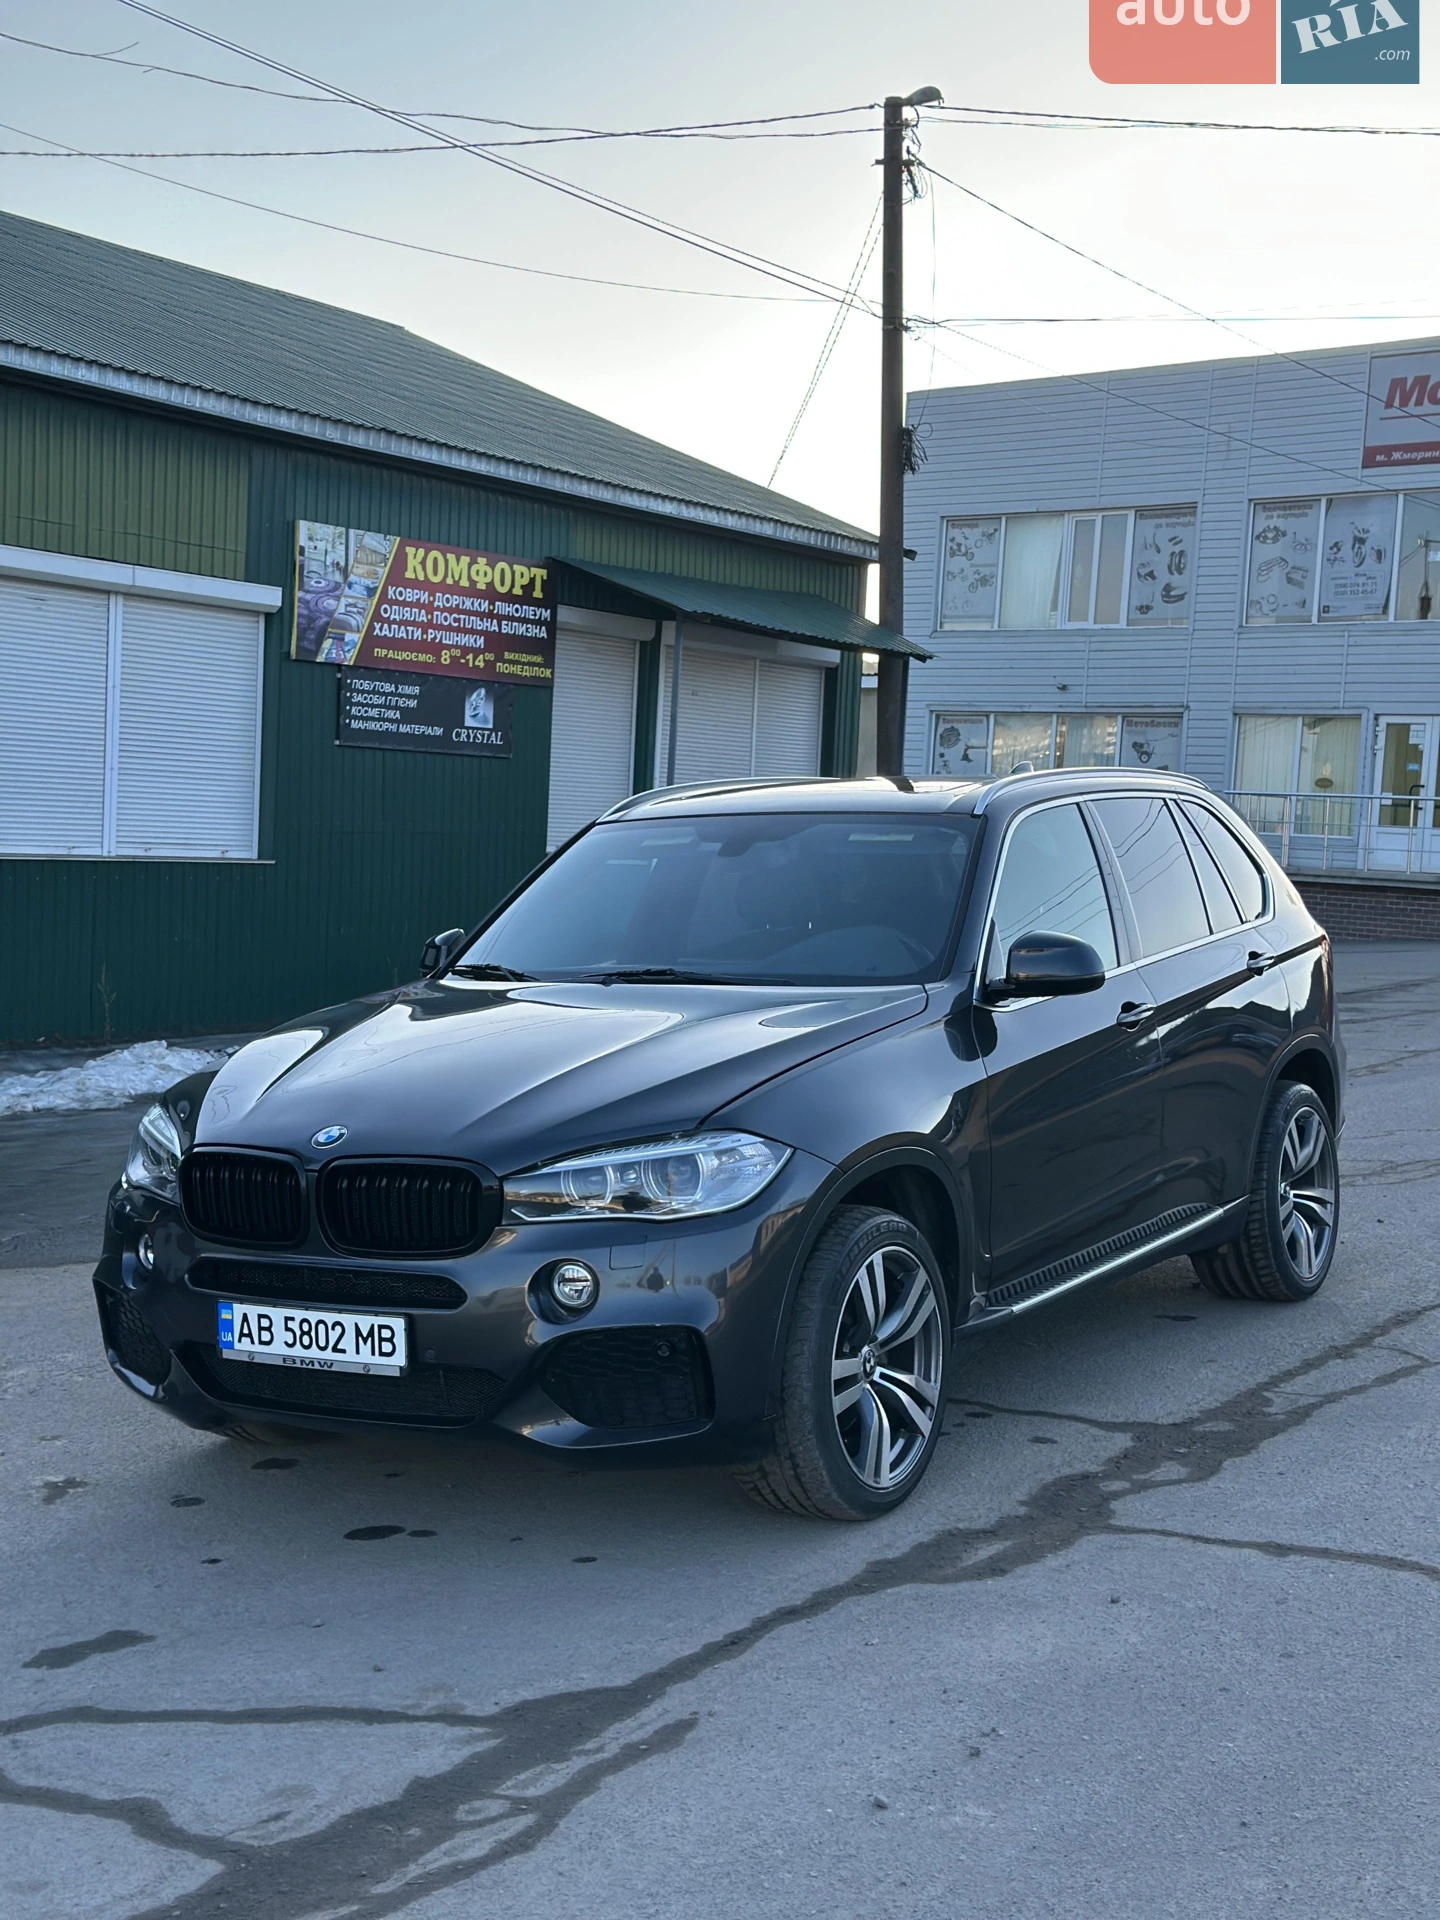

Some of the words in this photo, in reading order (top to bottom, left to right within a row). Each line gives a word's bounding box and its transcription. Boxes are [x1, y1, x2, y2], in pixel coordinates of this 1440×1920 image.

[404, 545, 548, 599] КОМФОРТ
[387, 585, 429, 604] КОВРИ
[433, 592, 489, 613] ДОРІЖКИ
[493, 601, 551, 622] ЛІНОЛЕУМ
[380, 604, 428, 623] ОДІЯЛА
[432, 611, 499, 633] ПОСТІЛЬНА
[501, 620, 548, 639] БІЛИЗНА
[373, 622, 422, 641] ХАЛАТИ
[427, 629, 485, 649] РУШНИКИ
[373, 648, 436, 663] ПРАЦЮЄМО:
[503, 651, 545, 664] ВИХІДНИЙ:
[495, 662, 552, 679] ПОНЕДІЛОК
[351, 679, 396, 693] ПОБУТОВА
[397, 685, 420, 696] ХІМІЯ
[351, 692, 385, 705] ЗАСОБИ
[386, 697, 418, 709] ГІГІЄНИ
[350, 706, 401, 720] КОСМЕТИКА
[350, 719, 397, 733] МАНІКЮРНІ
[398, 724, 444, 737] МАТЕРІАЛИ
[452, 728, 504, 745] CRYSTAL
[221, 1331, 233, 1342] UA
[237, 1312, 275, 1347] AB
[283, 1315, 347, 1354] 5802
[354, 1321, 397, 1358] MB
[282, 1357, 335, 1369] BMW
